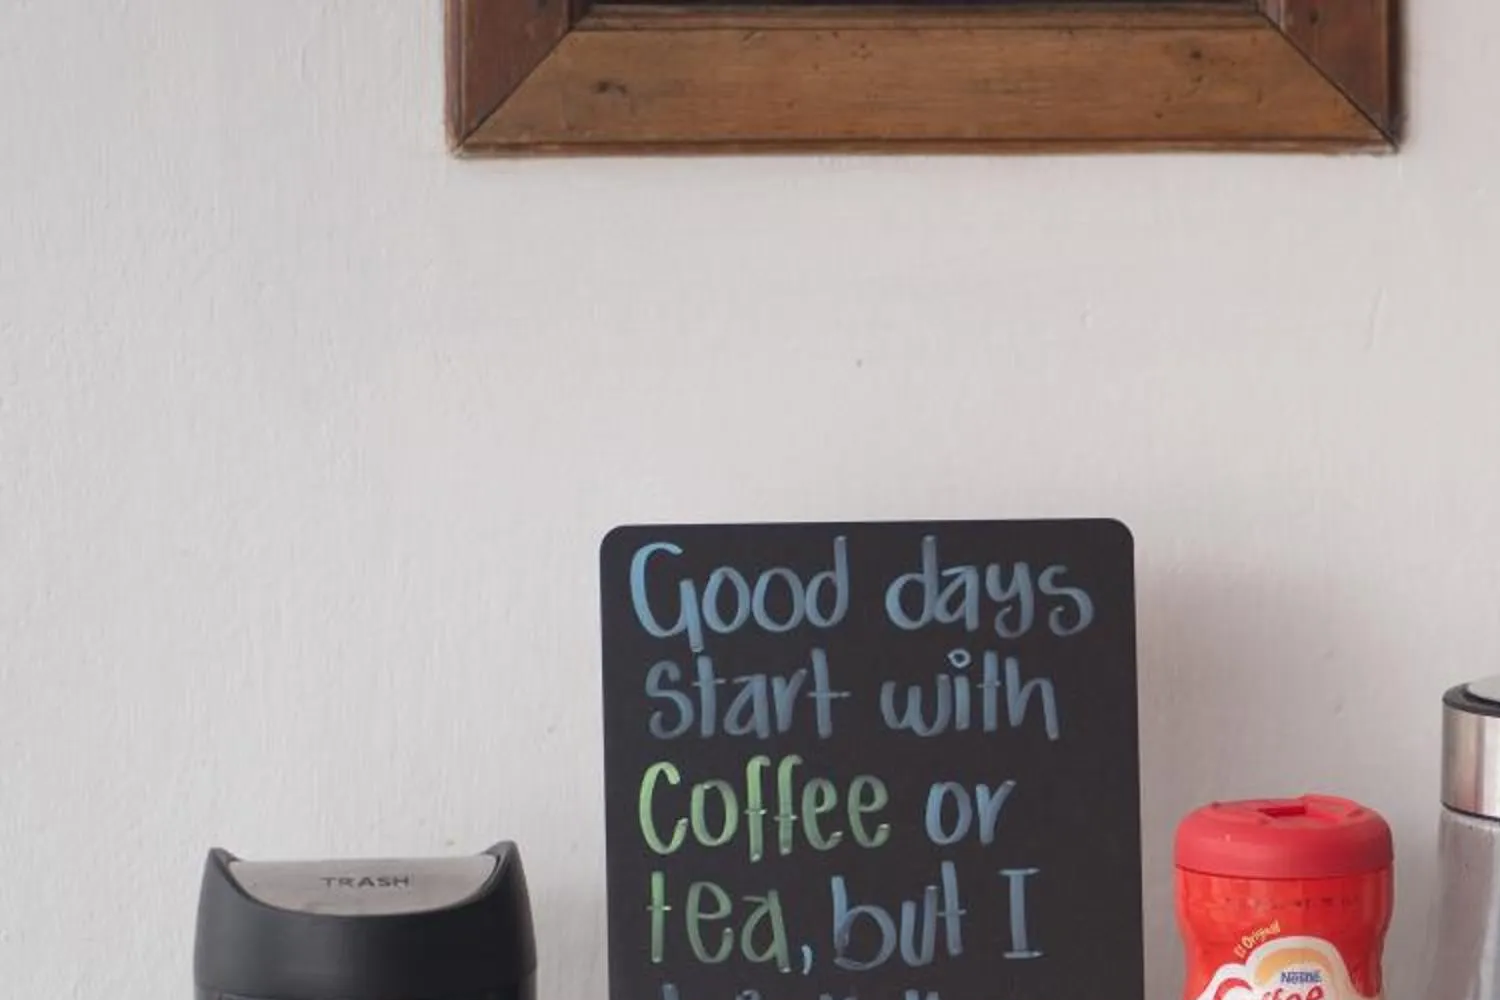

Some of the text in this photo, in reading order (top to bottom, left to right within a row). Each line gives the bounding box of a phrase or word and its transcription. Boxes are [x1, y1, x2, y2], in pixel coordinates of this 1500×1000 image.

[629, 535, 1095, 652] Good days
[645, 648, 1060, 740] start with
[638, 754, 1017, 863] Coffee or
[319, 876, 410, 889] TRASH
[830, 860, 967, 971] but
[999, 867, 1044, 959] I
[1241, 918, 1281, 949] Original
